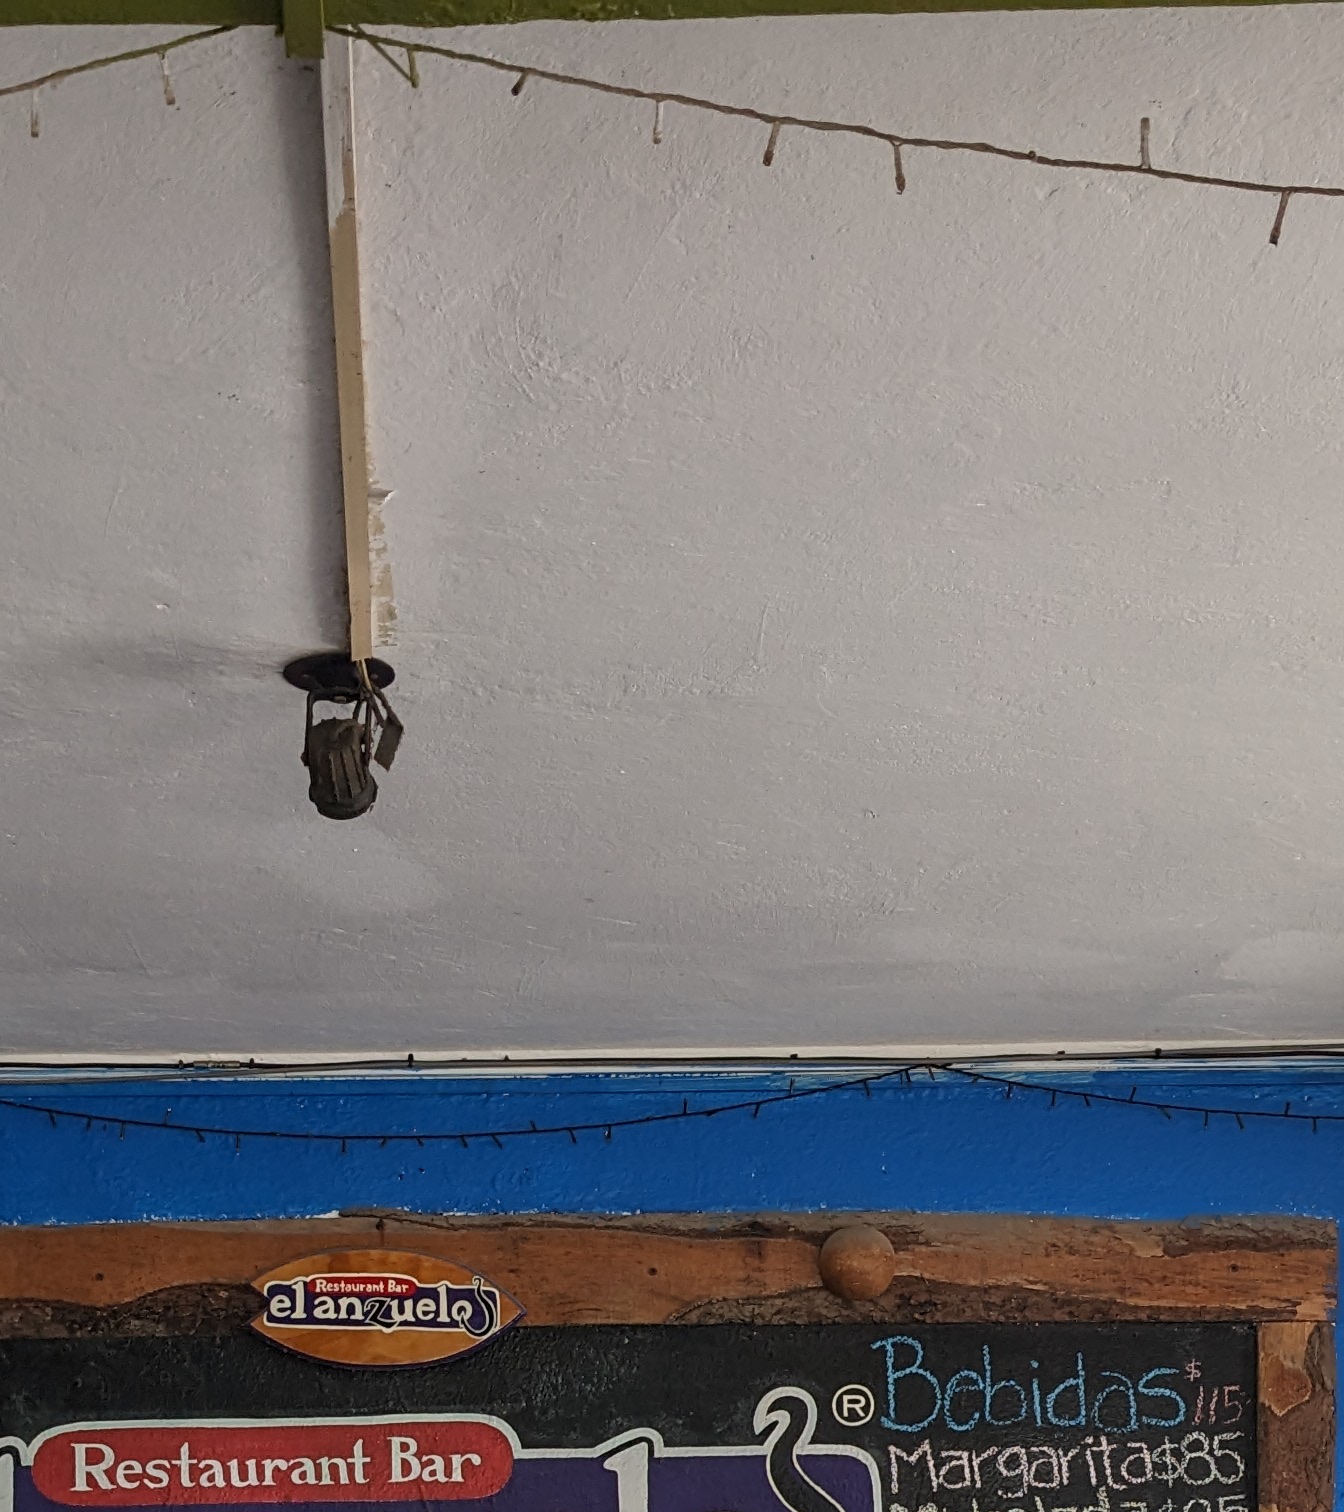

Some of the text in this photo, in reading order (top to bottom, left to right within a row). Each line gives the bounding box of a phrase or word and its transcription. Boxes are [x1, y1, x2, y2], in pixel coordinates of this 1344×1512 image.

[270, 1281, 473, 1330] el anzuelo
[315, 1279, 410, 1293] Restaurant Bar
[871, 1335, 1186, 1433] Bebidas
[68, 1436, 481, 1494] Restaurant Bar
[888, 1431, 1246, 1499] Margarita $85
